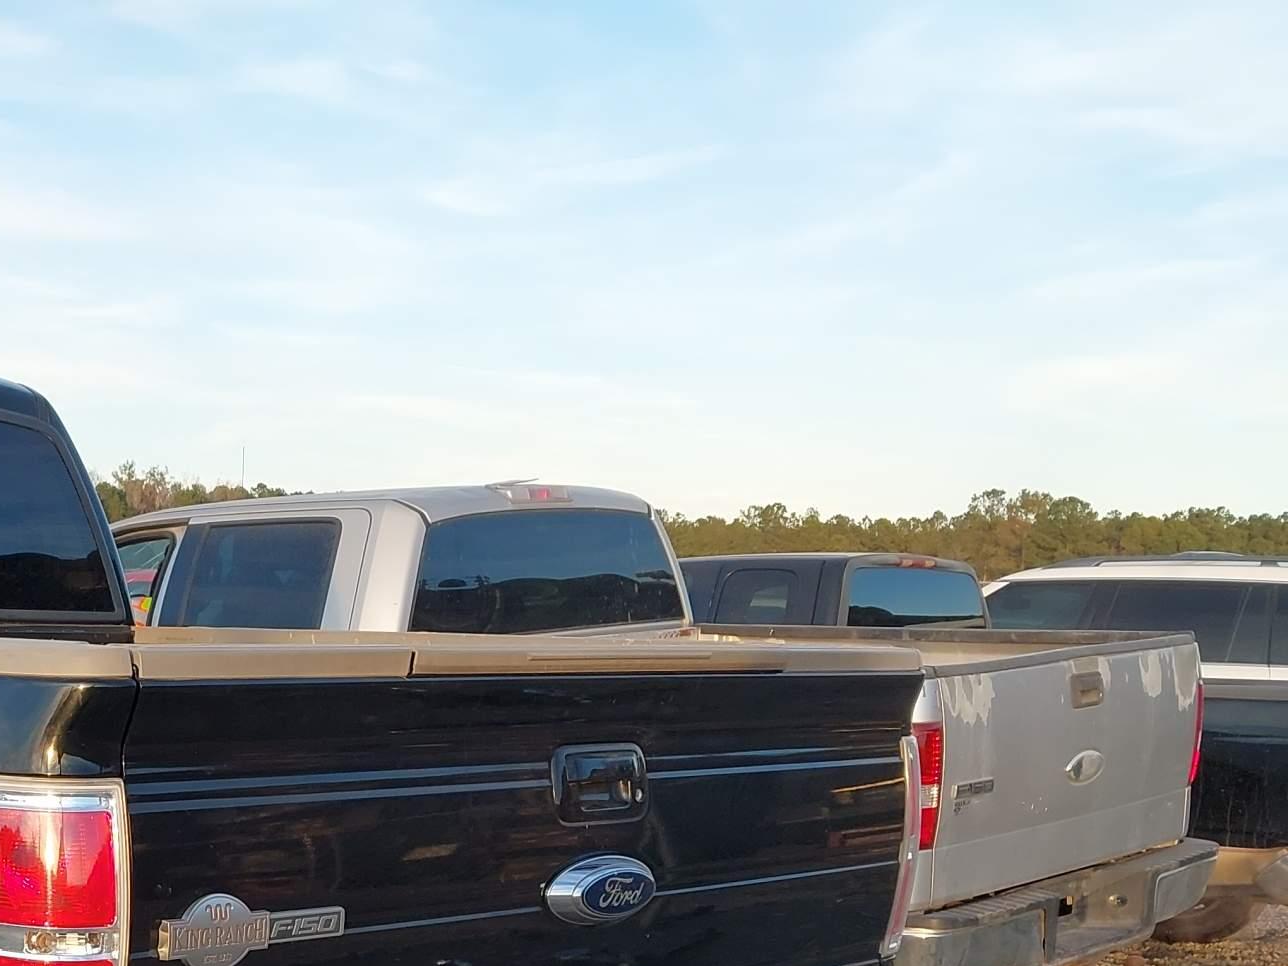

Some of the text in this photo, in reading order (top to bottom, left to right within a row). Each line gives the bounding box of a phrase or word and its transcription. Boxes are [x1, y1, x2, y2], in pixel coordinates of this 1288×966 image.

[598, 876, 644, 908] Ford
[174, 918, 265, 951] KING RANCH
